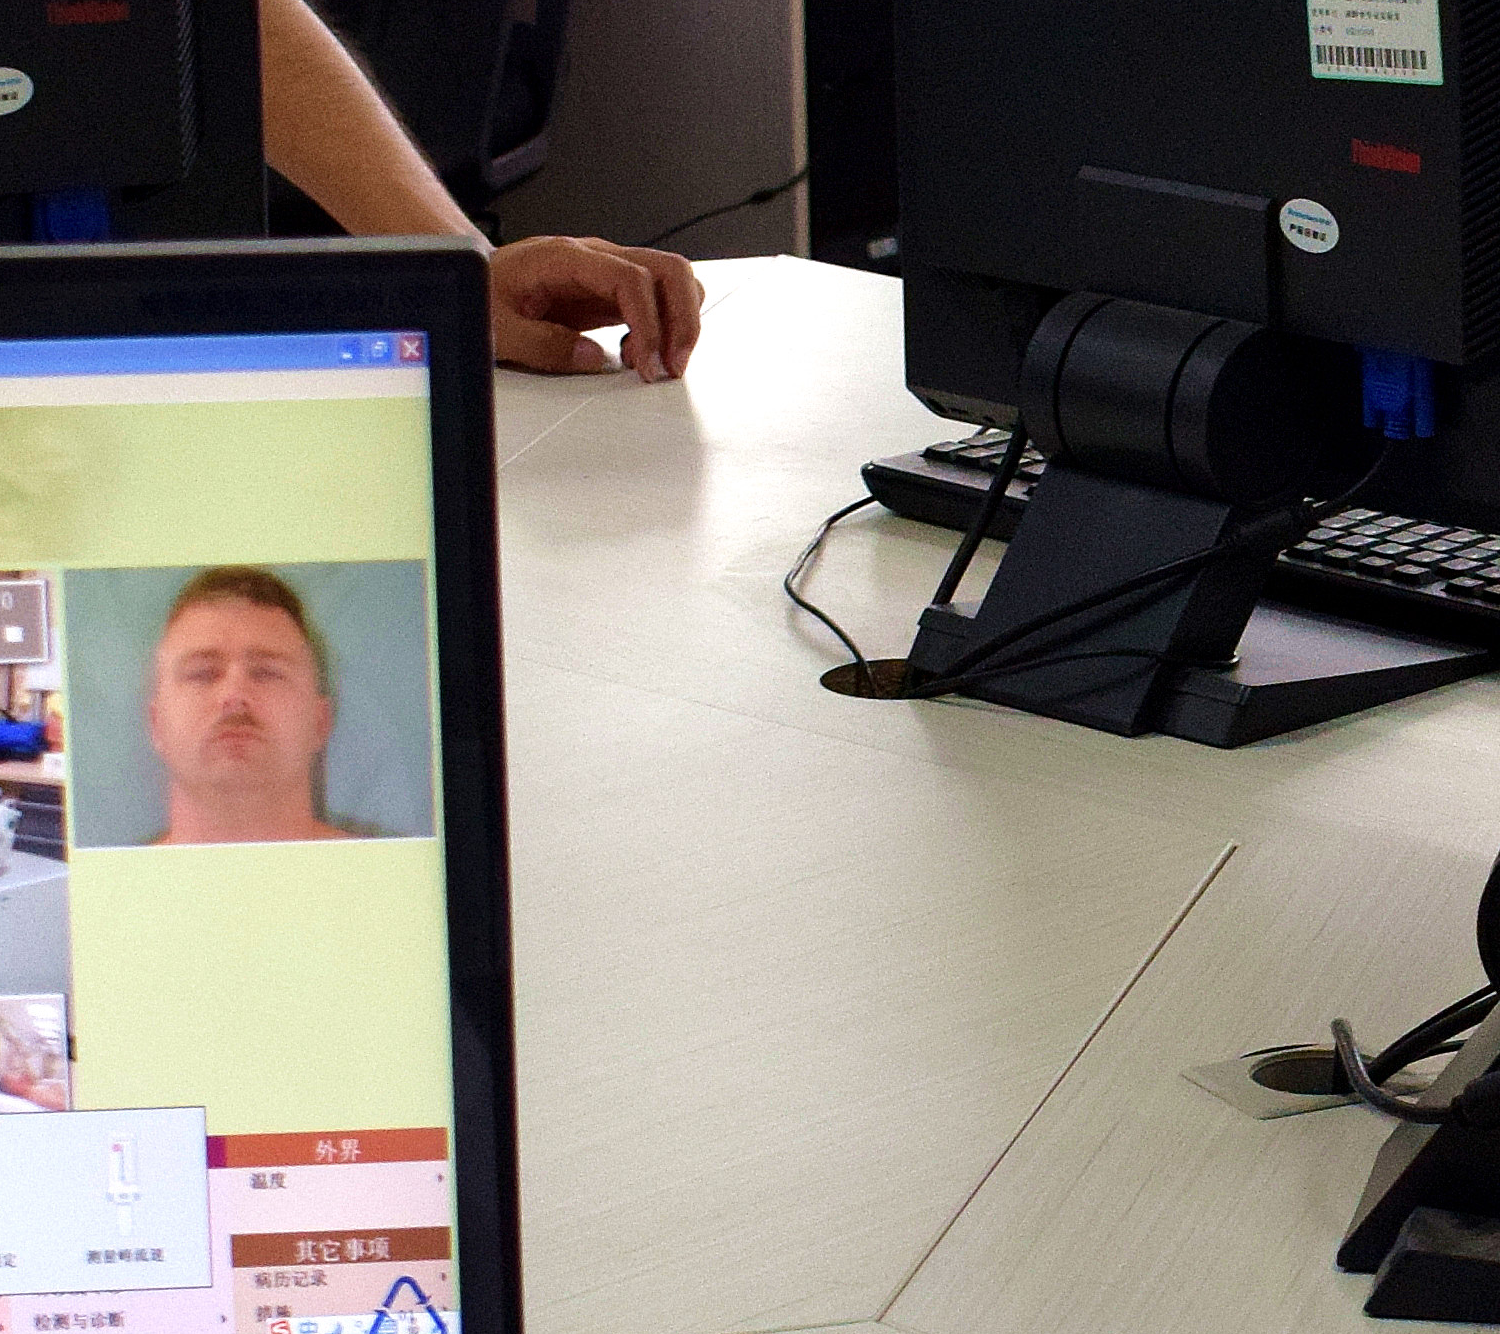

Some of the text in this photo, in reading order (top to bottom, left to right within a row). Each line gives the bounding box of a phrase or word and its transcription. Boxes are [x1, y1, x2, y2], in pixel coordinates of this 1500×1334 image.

[315, 1138, 362, 1162] 外界
[295, 1236, 391, 1262] 其它事项
